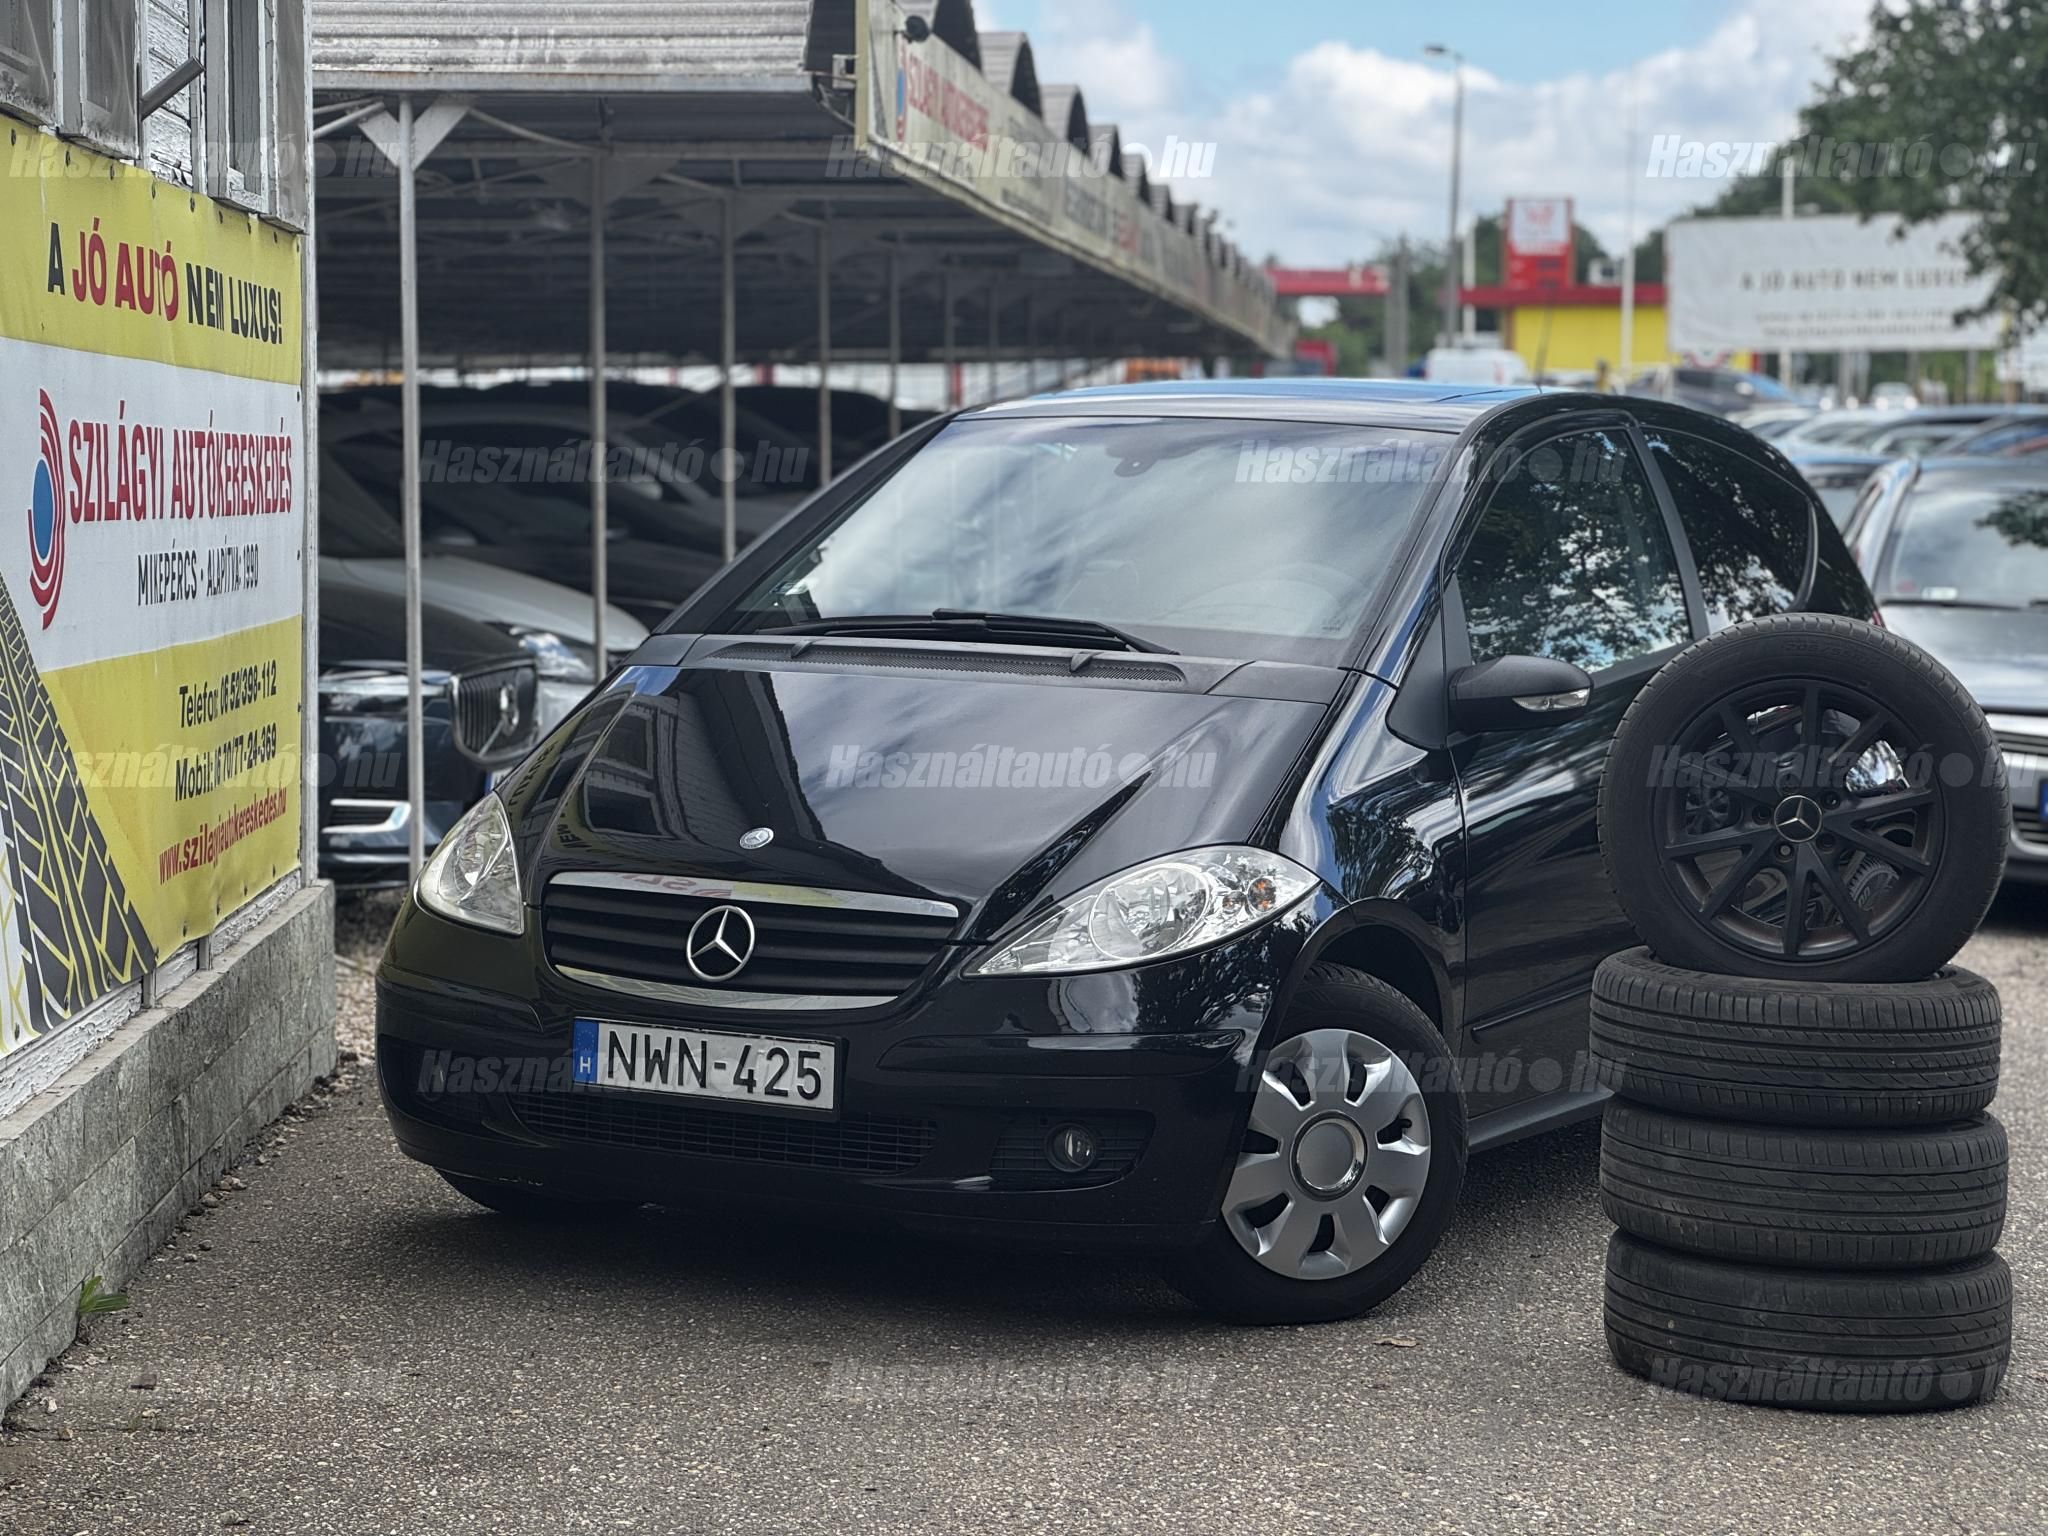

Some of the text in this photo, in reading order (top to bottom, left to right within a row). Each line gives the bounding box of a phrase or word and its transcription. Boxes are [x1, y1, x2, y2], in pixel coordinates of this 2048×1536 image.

[47, 217, 282, 344] A JÓ AUTÓ NEM LUXUS!
[69, 400, 292, 523] SZILÁGYI AUTÓKERESKEDÉS
[138, 538, 197, 606] MIKEPÉRCS
[243, 543, 259, 589] 1990
[179, 681, 219, 728] Telefo:
[175, 752, 214, 801] Mobil:
[579, 1056, 592, 1074] H
[607, 1030, 822, 1100] NWN-425
